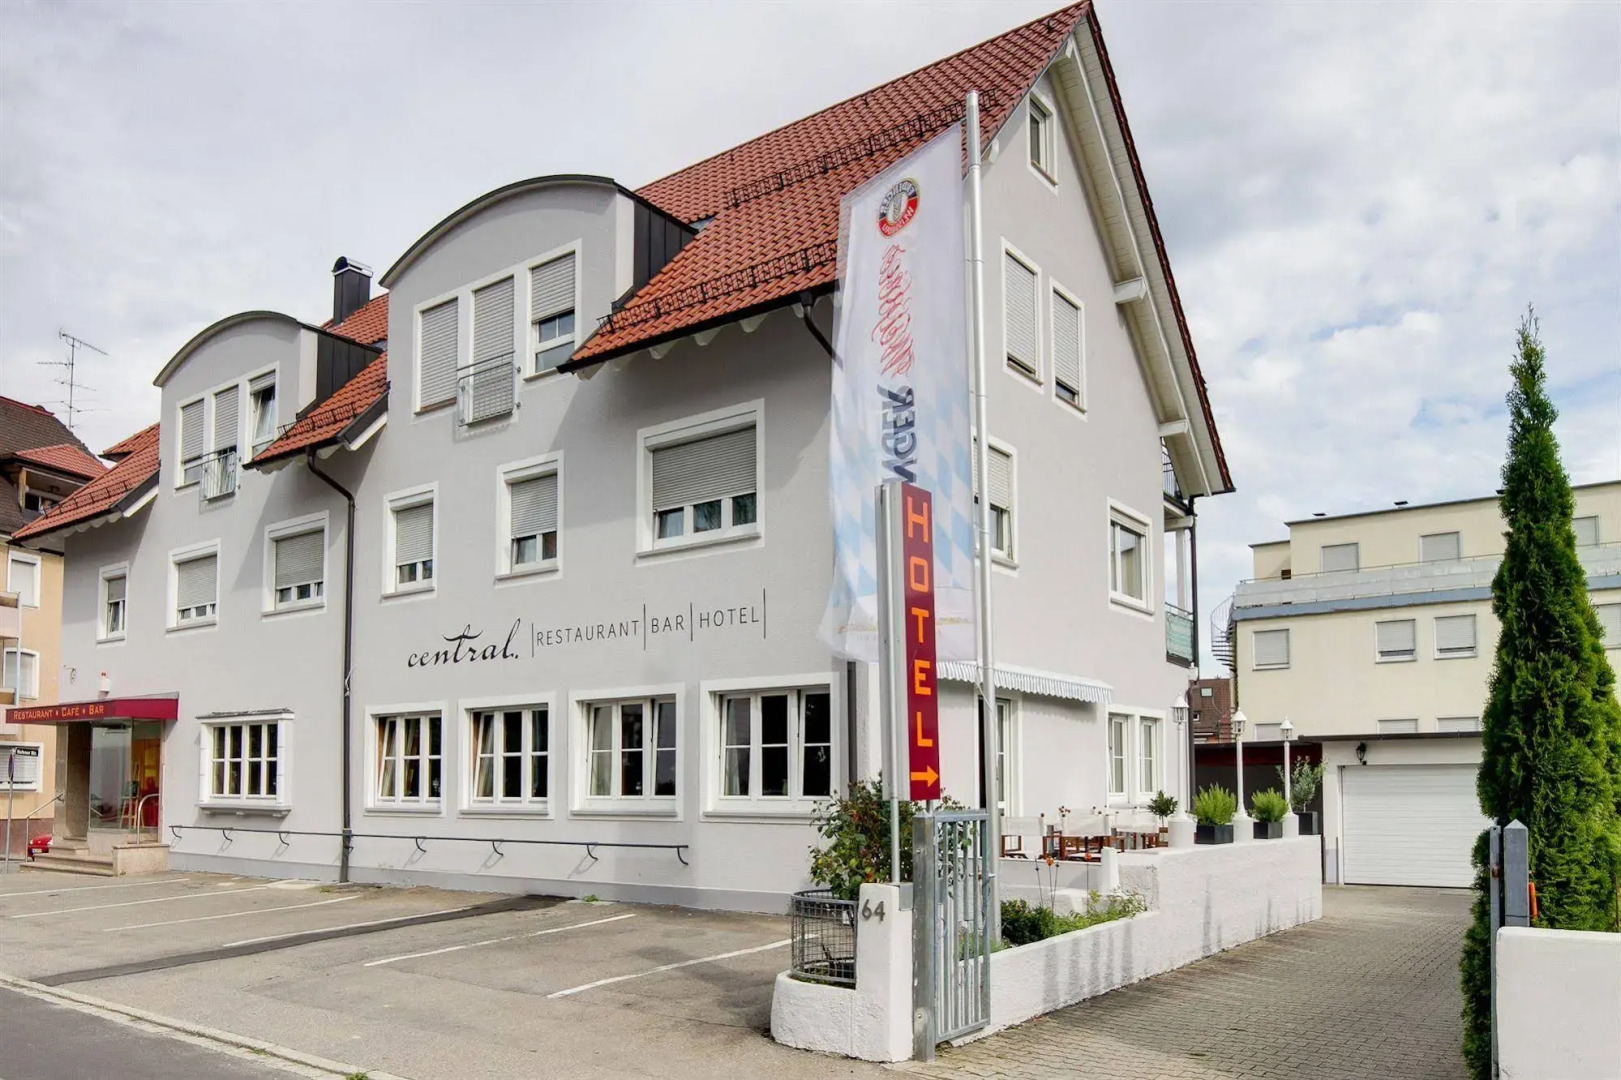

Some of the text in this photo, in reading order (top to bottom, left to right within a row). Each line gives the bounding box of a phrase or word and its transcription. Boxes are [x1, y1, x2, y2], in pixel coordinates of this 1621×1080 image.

[535, 606, 760, 647] RESTAURANT BAR HOTEL
[907, 496, 934, 747] HOTEL
[13, 709, 53, 720] RESTAURANT
[88, 704, 104, 715] BAR
[861, 899, 886, 921] 64
